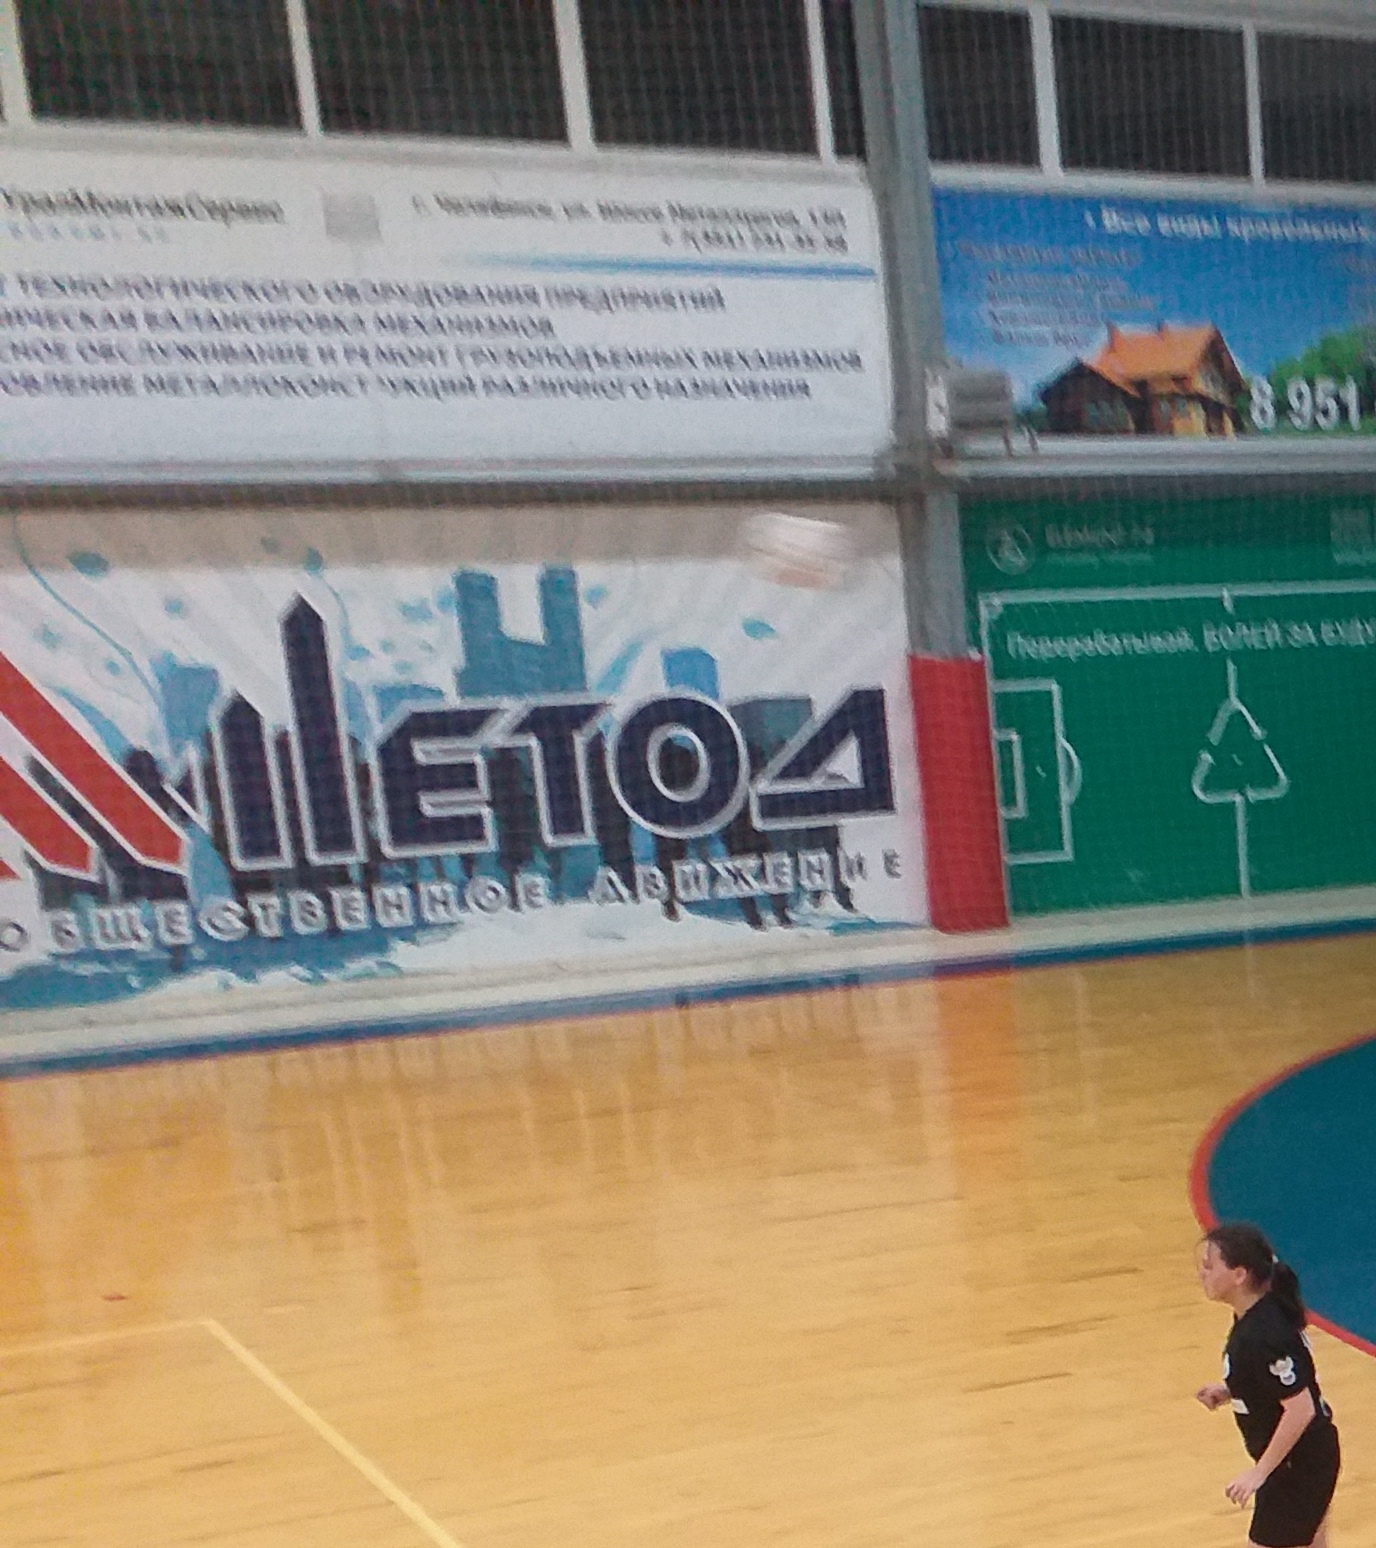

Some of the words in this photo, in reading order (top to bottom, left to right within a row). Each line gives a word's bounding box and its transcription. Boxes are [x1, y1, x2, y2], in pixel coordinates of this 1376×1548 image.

[1250, 375, 1276, 431] 8
[1286, 374, 1361, 431] 951
[588, 848, 903, 904] ДВИЖЕНИЕ
